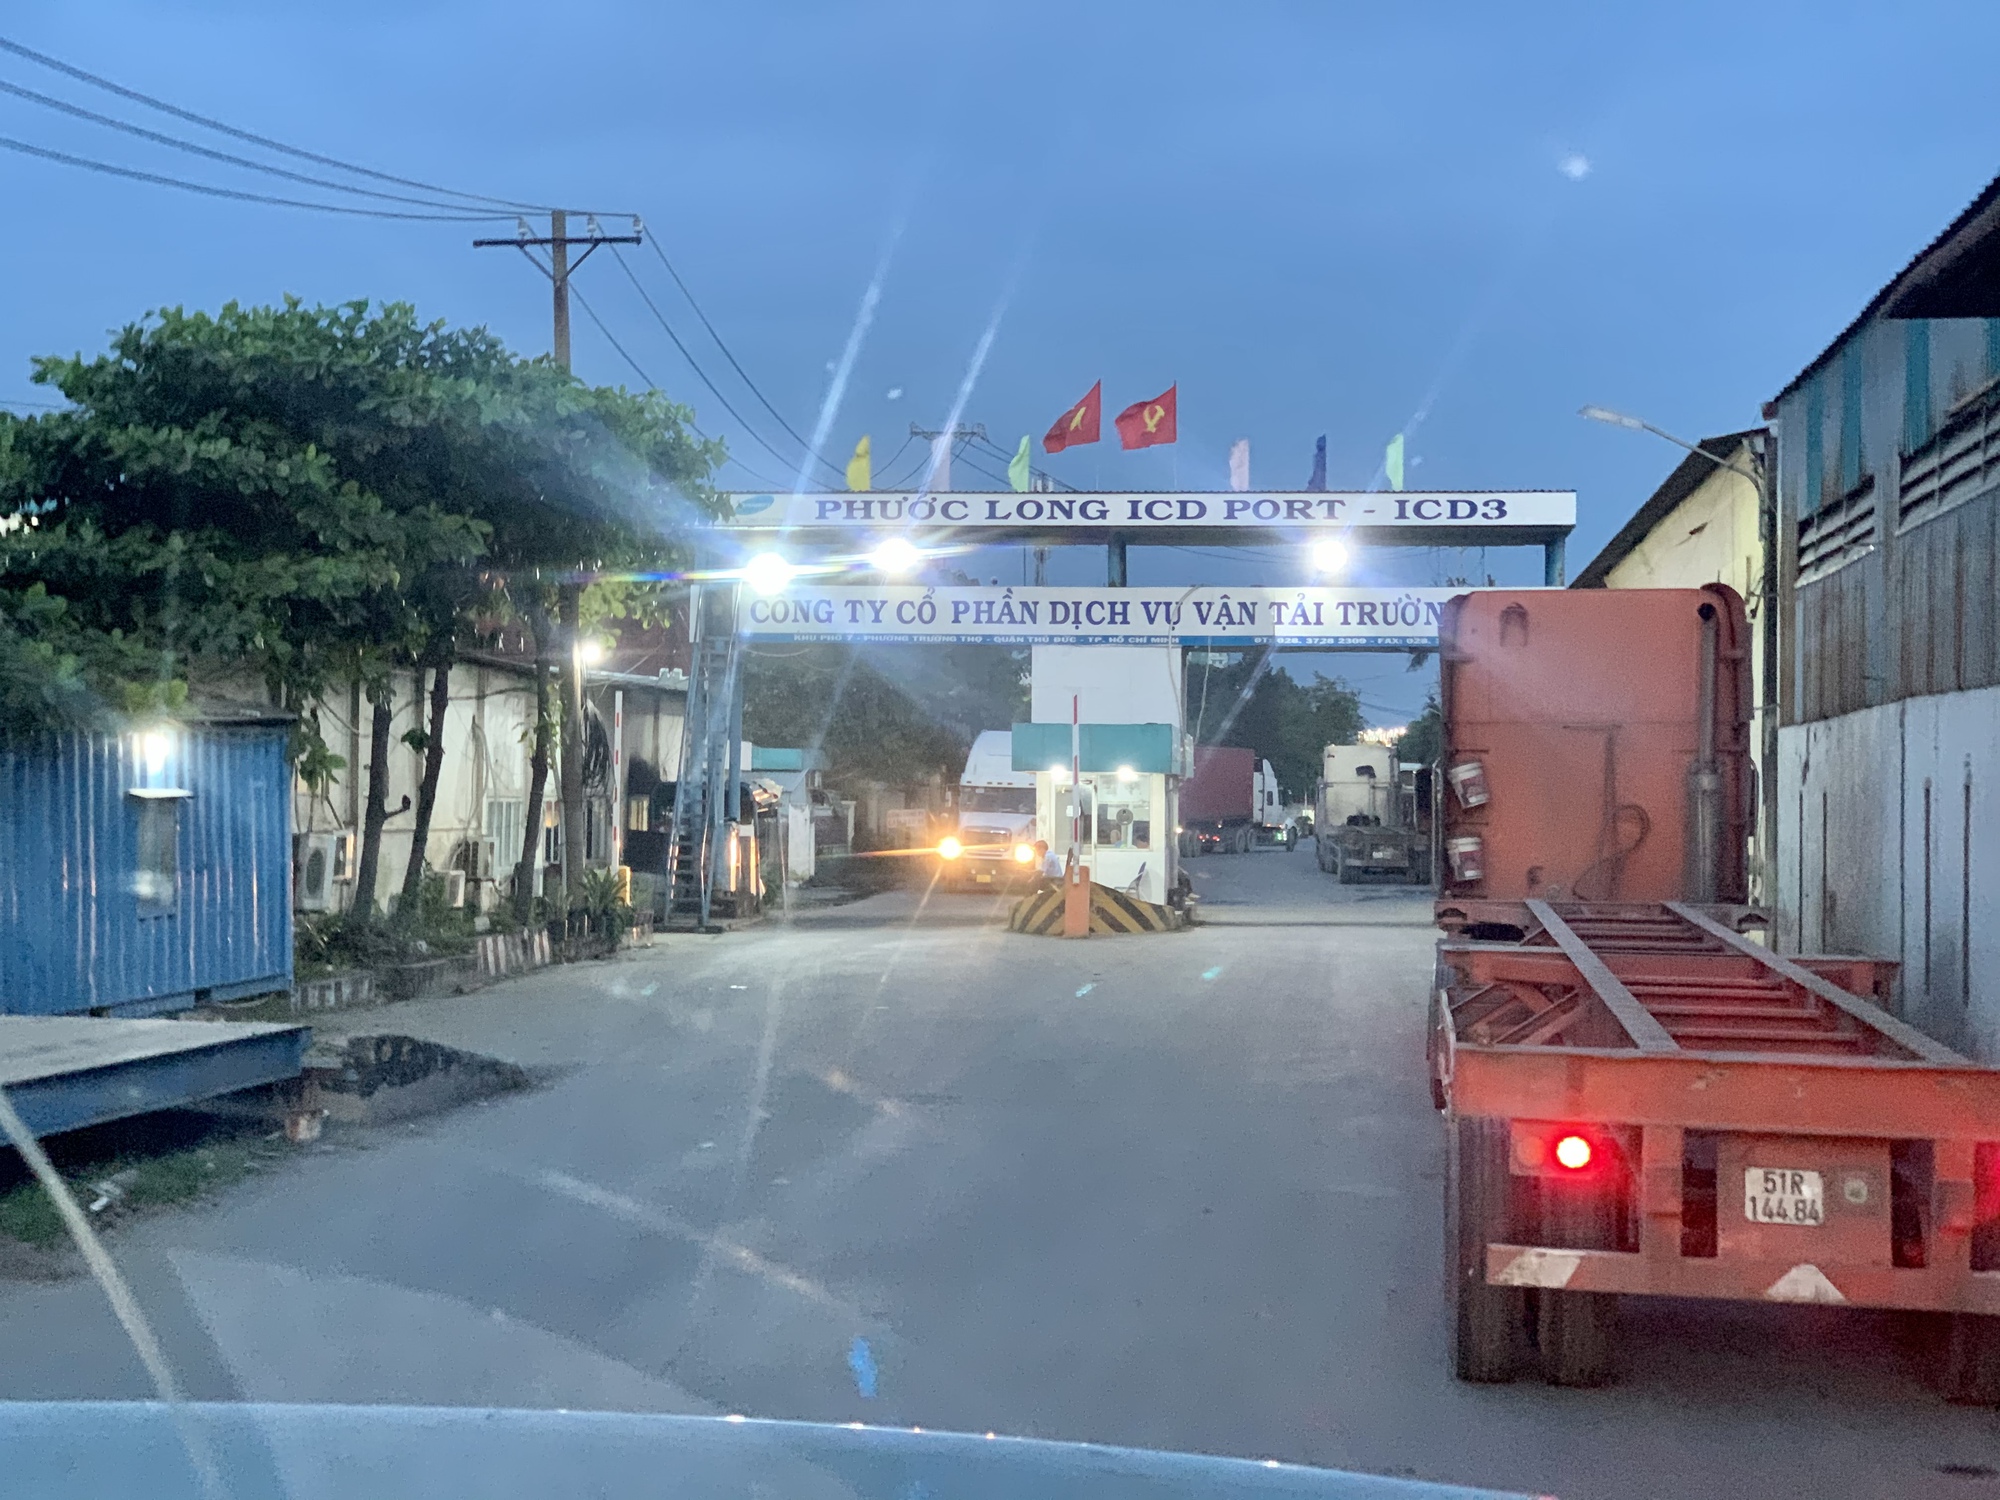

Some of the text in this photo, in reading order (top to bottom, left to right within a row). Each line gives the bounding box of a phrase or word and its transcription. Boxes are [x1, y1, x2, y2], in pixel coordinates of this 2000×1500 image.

[815, 493, 969, 520] PHƯỚC
[985, 499, 1110, 520] LONG
[1127, 499, 1207, 520] ICD
[1223, 499, 1346, 520] PORT
[1394, 498, 1508, 520] ICD3
[750, 592, 835, 624] CÔNG
[844, 600, 888, 624] TY
[896, 586, 937, 625] CỔ
[951, 587, 1040, 625] PHẦN
[1049, 600, 1131, 630] DỊCH
[1140, 601, 1184, 631] VỤ
[1192, 594, 1258, 631] VẬN
[1268, 592, 1325, 626] TẢI
[1763, 1170, 1803, 1195] 51R
